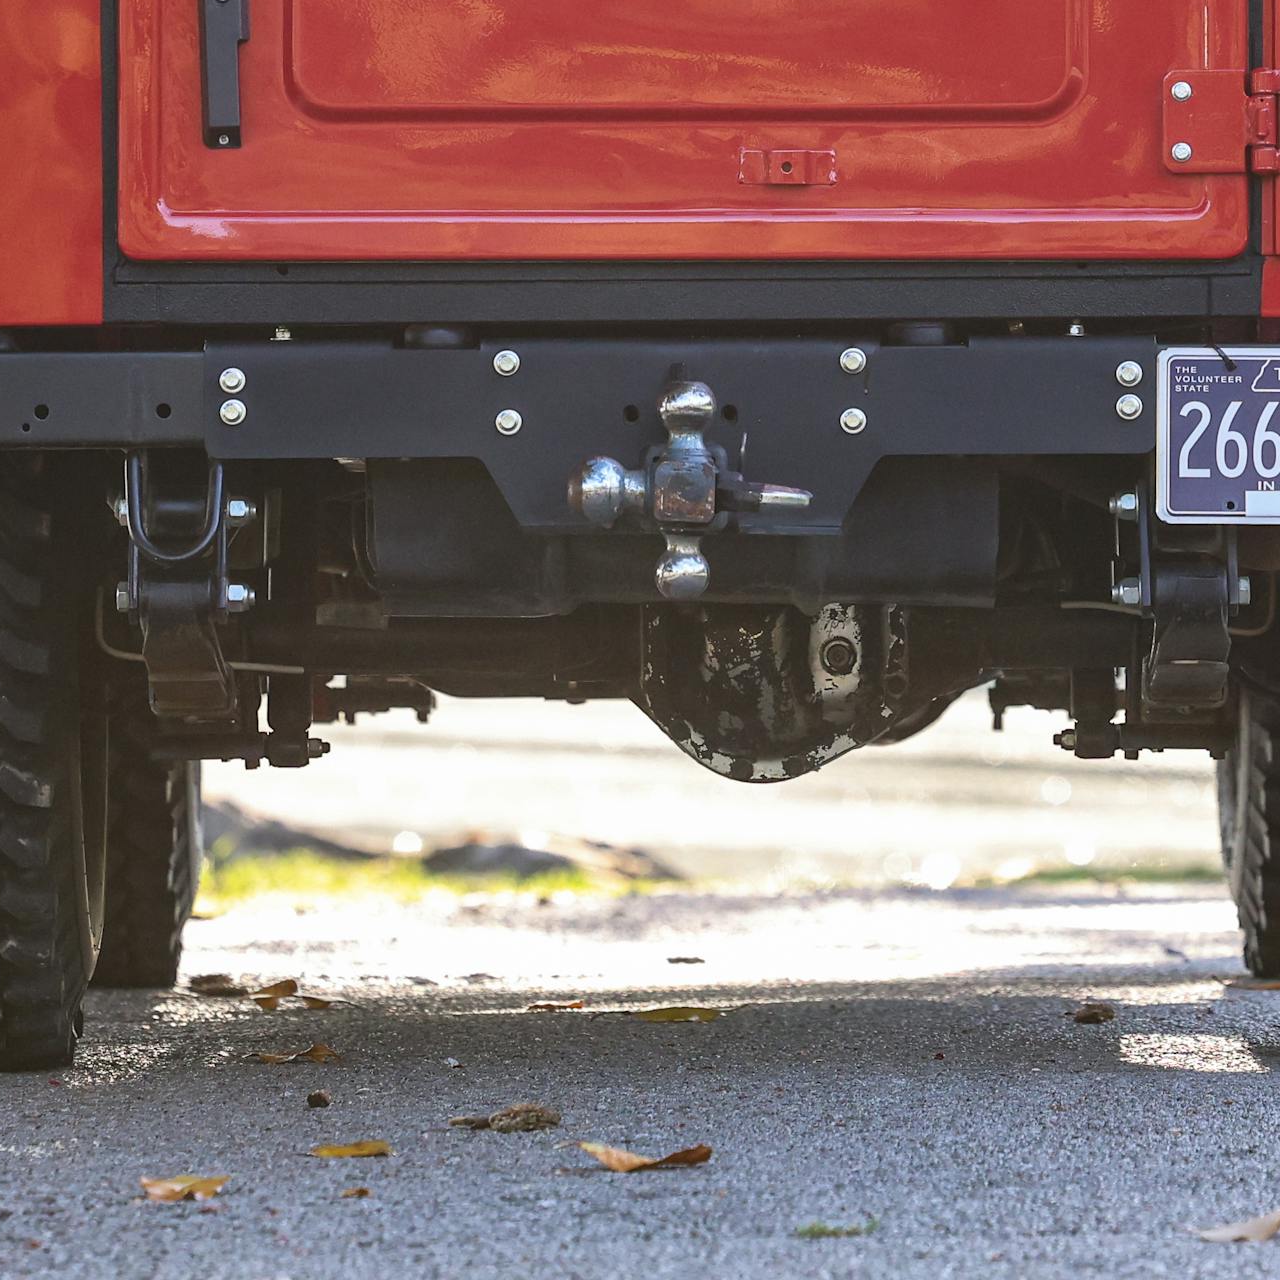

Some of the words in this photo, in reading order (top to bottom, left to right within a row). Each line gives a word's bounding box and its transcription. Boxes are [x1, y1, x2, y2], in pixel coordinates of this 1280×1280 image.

[1175, 366, 1197, 374] THE
[1175, 376, 1242, 384] VOLUNTEER
[1175, 385, 1210, 393] STATE
[1257, 480, 1275, 491] IN
